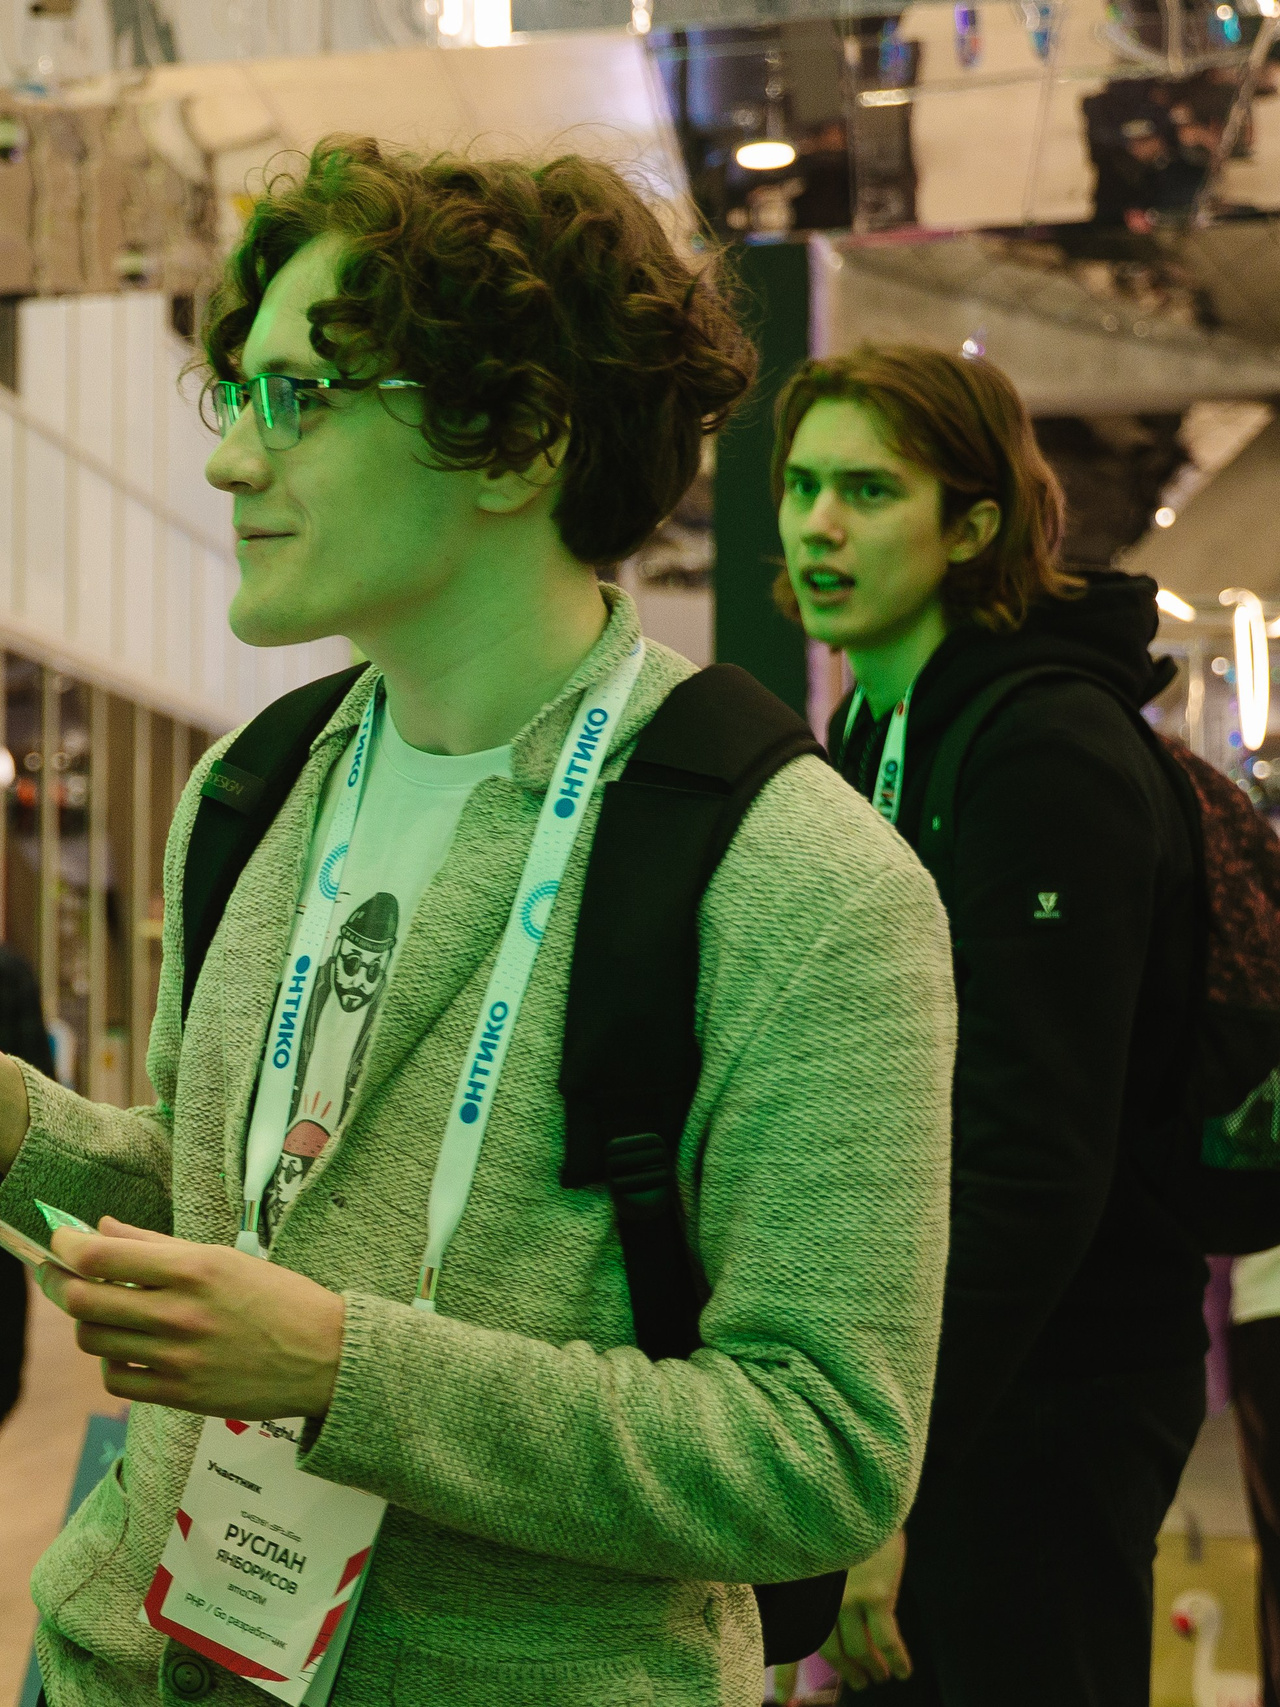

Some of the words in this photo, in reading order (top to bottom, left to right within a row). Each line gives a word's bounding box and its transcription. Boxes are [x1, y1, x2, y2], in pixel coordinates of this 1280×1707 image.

[207, 1459, 263, 1495] Участник
[215, 1548, 299, 1595] ЯНБОРИСОВ
[224, 1523, 307, 1574] РУСЛАН
[227, 1583, 267, 1607] amoCRM
[185, 1592, 206, 1608] PHP
[213, 1606, 227, 1620] Go
[226, 1615, 288, 1650] разработчик
